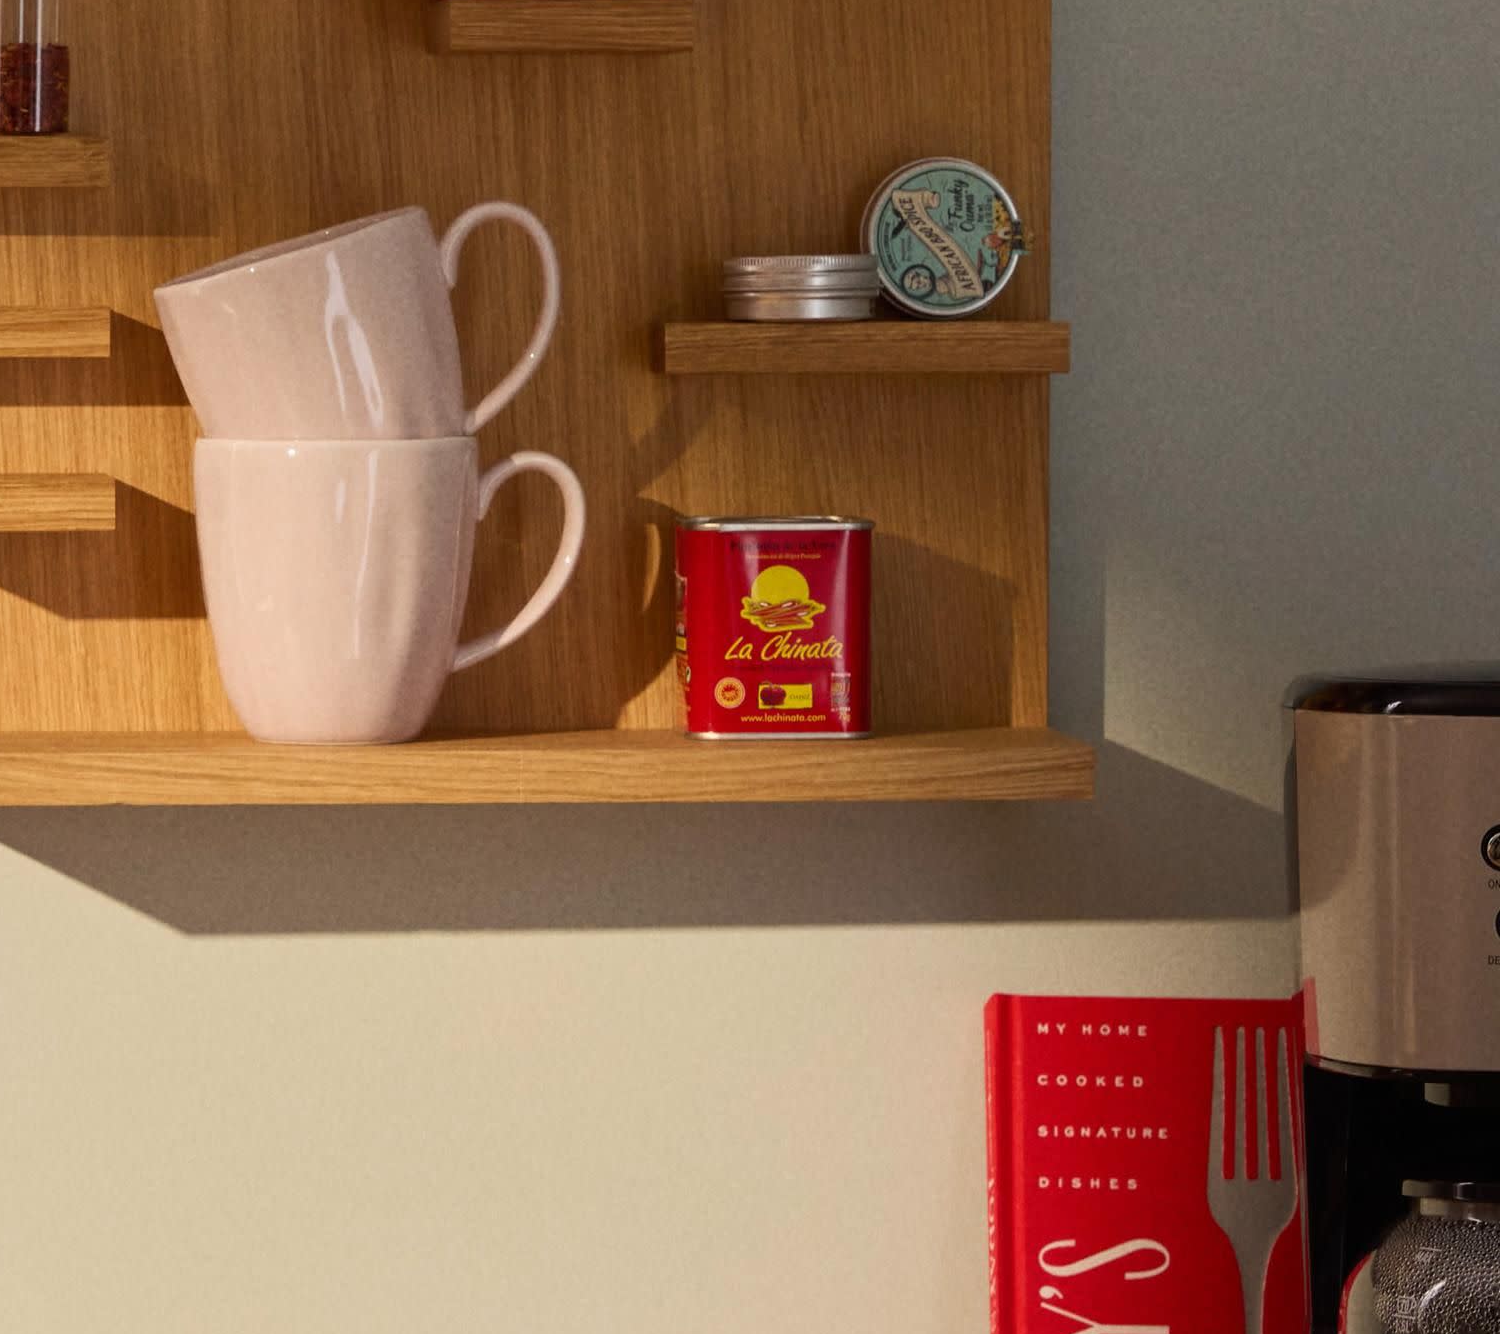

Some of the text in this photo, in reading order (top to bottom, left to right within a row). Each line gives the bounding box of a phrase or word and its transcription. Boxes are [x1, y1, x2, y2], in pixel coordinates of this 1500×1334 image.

[948, 179, 969, 219] Funky
[899, 197, 926, 226] SPICE
[940, 246, 976, 290] AFRICAN
[724, 632, 844, 661] La Chinata
[740, 713, 827, 722] www.lachinata.com
[1037, 1023, 1147, 1037] MY HOME
[1037, 1074, 1144, 1087] COOKED
[1037, 1125, 1168, 1139] SIGNATURE
[1038, 1176, 1138, 1190] DISHES
